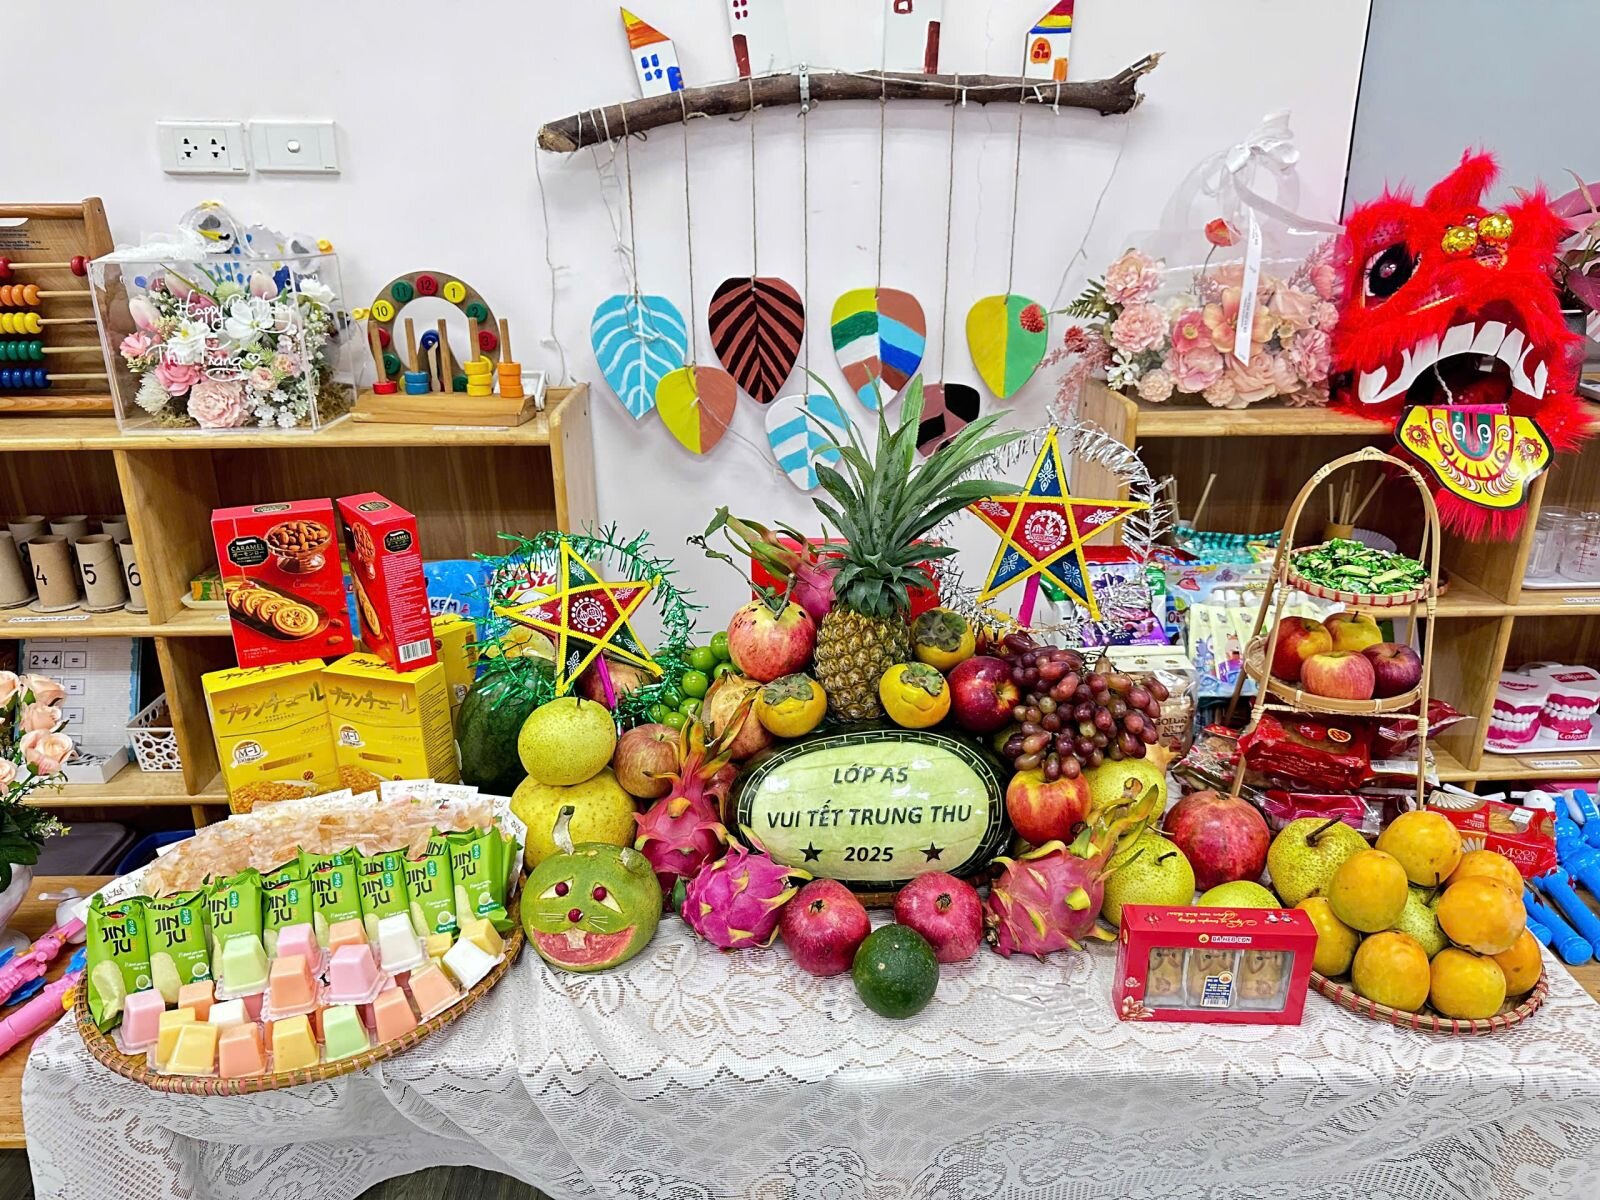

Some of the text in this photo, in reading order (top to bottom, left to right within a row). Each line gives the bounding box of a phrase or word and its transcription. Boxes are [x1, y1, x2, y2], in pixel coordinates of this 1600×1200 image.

[397, 284, 407, 297] 11
[420, 280, 433, 291] 12
[451, 287, 456, 298] 1
[174, 289, 226, 332] Happy
[376, 306, 389, 317] 10
[471, 307, 479, 318] 2
[482, 335, 490, 346] 3
[230, 543, 265, 552] CARAMEL
[36, 564, 48, 586] 4
[83, 563, 97, 585] 5
[127, 562, 141, 587] 6
[430, 599, 458, 613] KEM
[31, 655, 39, 665] 2
[51, 655, 59, 665] 4
[1499, 680, 1539, 689] olgate
[1488, 740, 1519, 749] Colgate
[1558, 732, 1589, 740] Colgate
[880, 767, 908, 783] A5
[767, 799, 972, 828] VUI TẾT TRUNG THU
[844, 846, 894, 862] 2025
[1496, 844, 1538, 858] MOON
[453, 850, 473, 870] JIN
[406, 867, 427, 886] JIN
[461, 862, 477, 880] JU
[312, 878, 332, 895] JIN
[362, 879, 384, 897] JIN
[414, 879, 432, 897] JU
[267, 895, 287, 912] JIN
[319, 891, 338, 908] JU
[371, 891, 390, 909] JU
[213, 911, 233, 929] JU
[274, 907, 292, 925] JU
[102, 924, 127, 943] JIN
[155, 915, 180, 935] JIN
[166, 928, 187, 948] JU
[113, 938, 132, 957] JU
